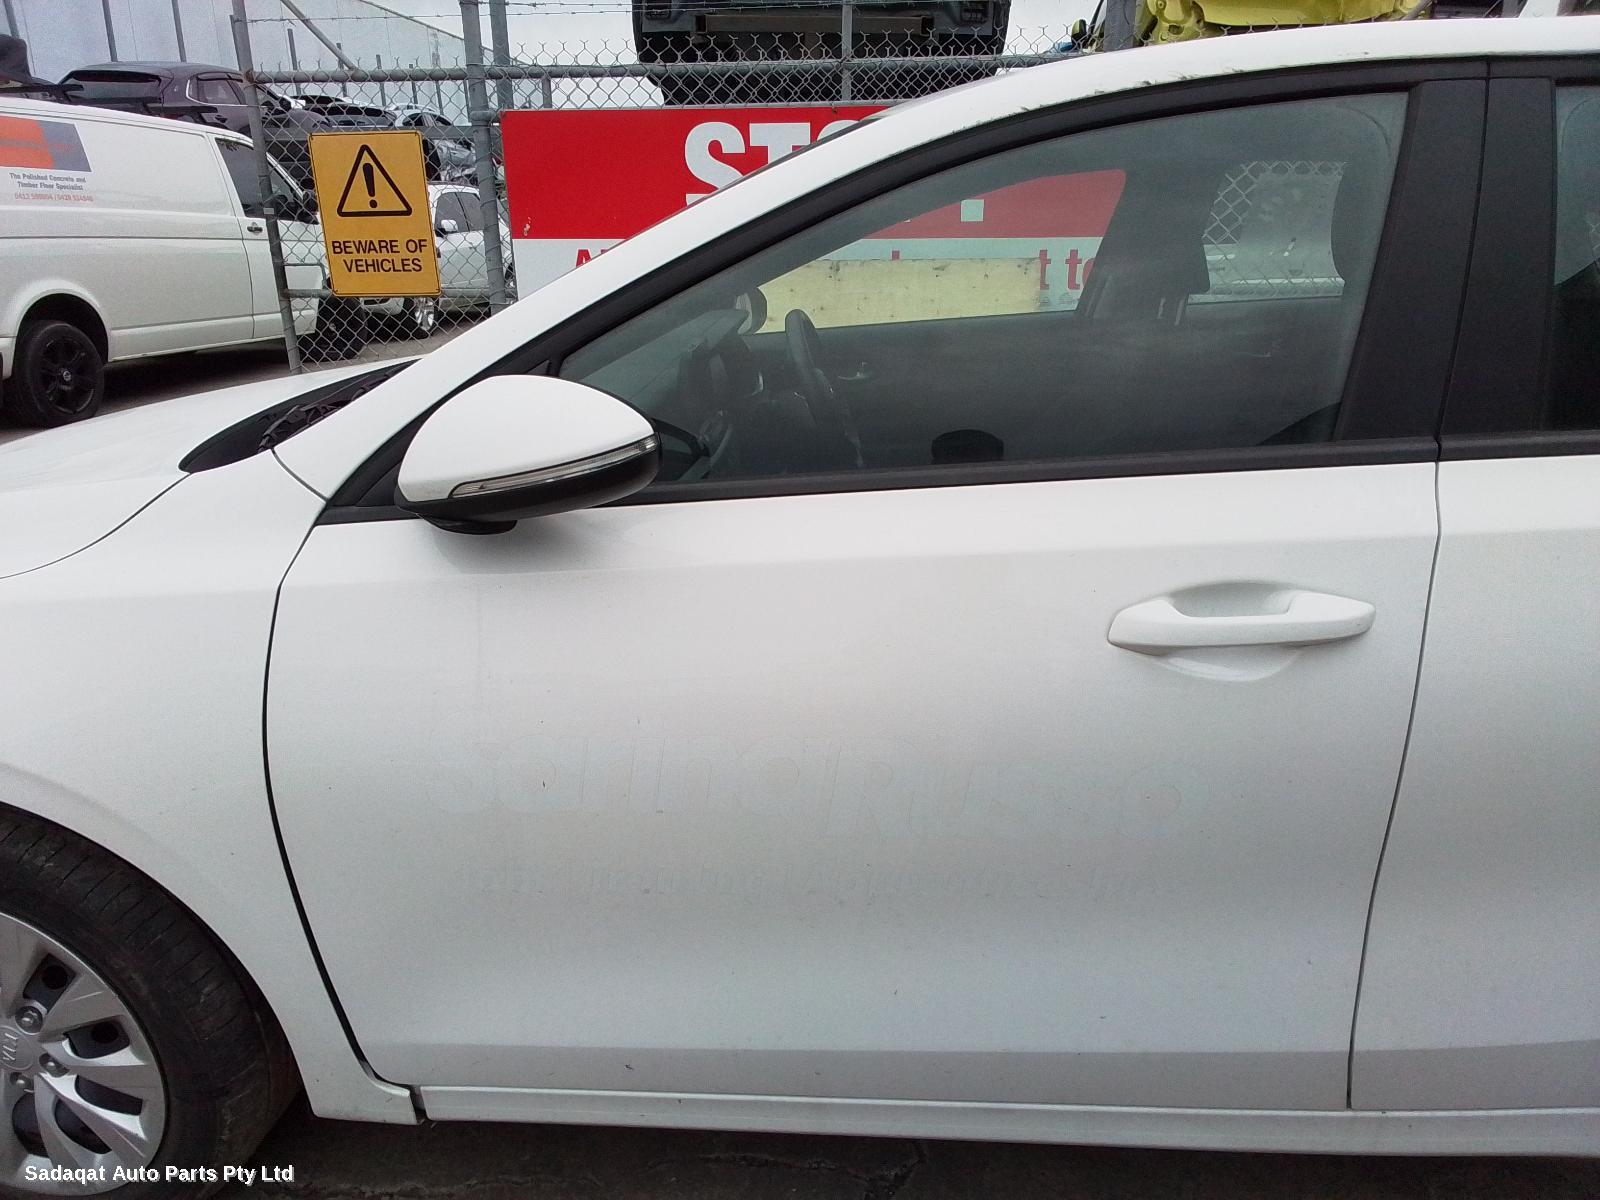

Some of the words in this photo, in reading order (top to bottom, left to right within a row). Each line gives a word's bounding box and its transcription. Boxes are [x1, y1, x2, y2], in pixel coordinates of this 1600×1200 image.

[9, 172, 21, 180] The
[22, 173, 48, 181] Polished
[49, 174, 75, 182] Concrete
[17, 181, 39, 189] Timber
[56, 183, 84, 191] Specialist
[331, 239, 400, 254] BEWARE
[405, 239, 428, 253] OF
[342, 258, 423, 273] VEHICLES
